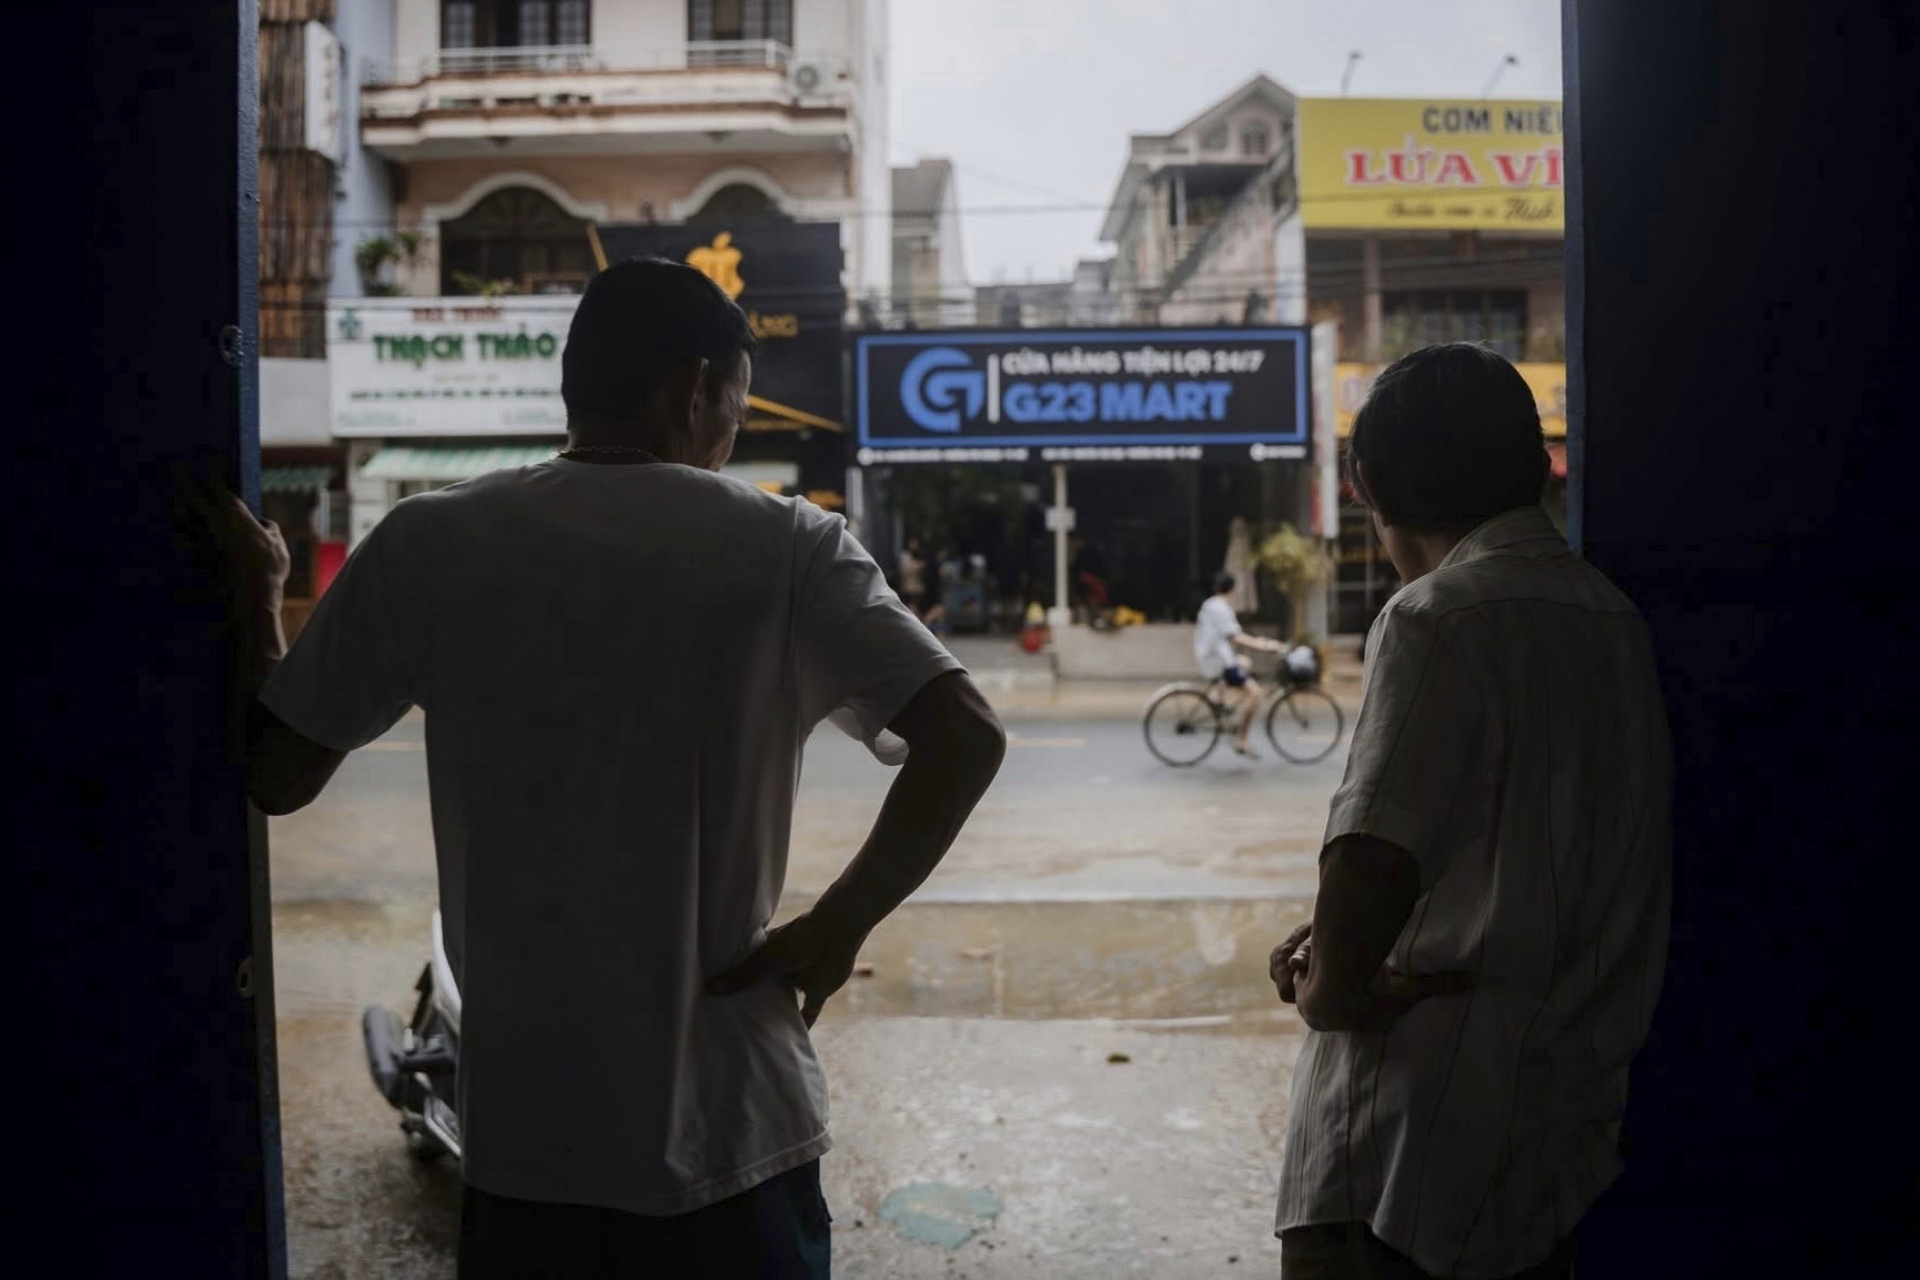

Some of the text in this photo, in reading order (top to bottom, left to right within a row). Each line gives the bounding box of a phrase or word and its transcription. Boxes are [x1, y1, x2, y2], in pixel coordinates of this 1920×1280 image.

[1504, 104, 1563, 134] NIÊ
[372, 333, 465, 370] THẠCH
[1051, 345, 1121, 375] HÀNG
[1122, 345, 1171, 377] TIỆN
[1212, 349, 1265, 374] 24/7
[1002, 379, 1233, 423] G23 MART
